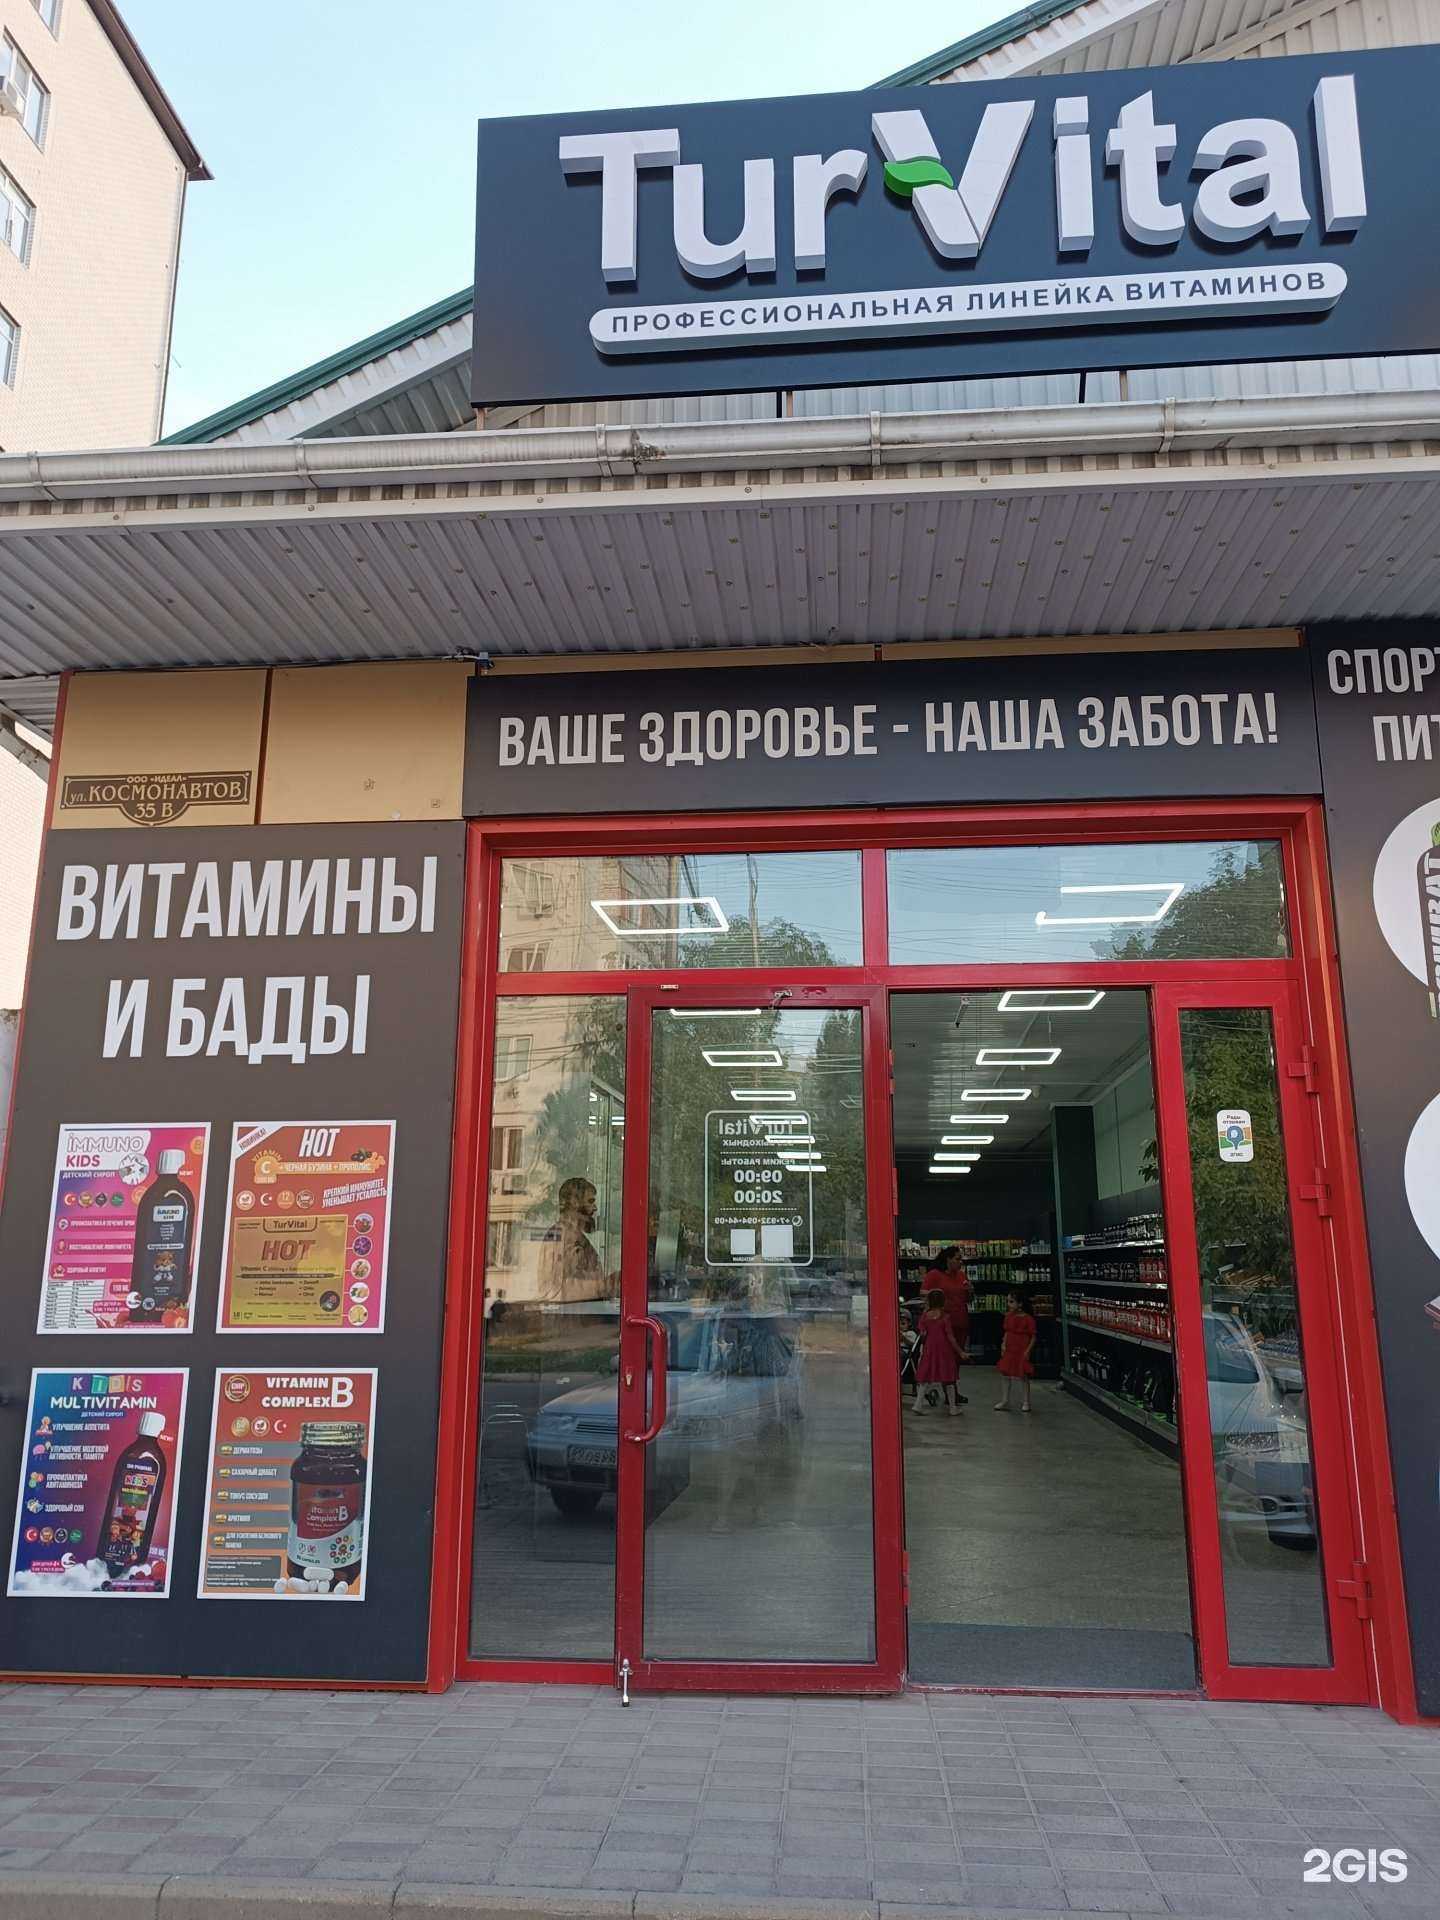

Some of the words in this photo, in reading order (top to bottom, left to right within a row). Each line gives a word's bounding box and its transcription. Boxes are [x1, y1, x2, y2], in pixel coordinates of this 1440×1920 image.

[559, 75, 1367, 284] TurVital
[611, 294, 954, 333] ПРОФЕССИОНАЛЬНАЯ
[966, 283, 1114, 311] ЛИНЕЙКА
[1126, 271, 1326, 301] ВИТАМИНОВ
[499, 713, 626, 767] ВАШЕ
[639, 704, 878, 767] ЗДОРОВЬЕ
[924, 698, 1065, 753] НАША
[1077, 692, 1279, 749] ЗАБОТА!
[126, 775, 148, 783] ООО
[69, 792, 87, 805] ул.
[88, 781, 242, 802] КОСМОНАВТОВ
[134, 802, 156, 818] 35
[161, 802, 174, 818] В
[56, 855, 439, 941] ВИТАМИНЫ
[102, 978, 150, 1058] И
[166, 974, 371, 1065] БАДЫ
[298, 1128, 341, 1157] HOT
[66, 1154, 101, 1168] KIDS
[272, 1220, 308, 1229] TurVital
[261, 1239, 316, 1261] HOT
[50, 1396, 158, 1409] MULTIVITAMIN
[261, 1396, 331, 1408] COMPLEX
[266, 1377, 329, 1389] VITAMIN
[331, 1376, 354, 1408] B
